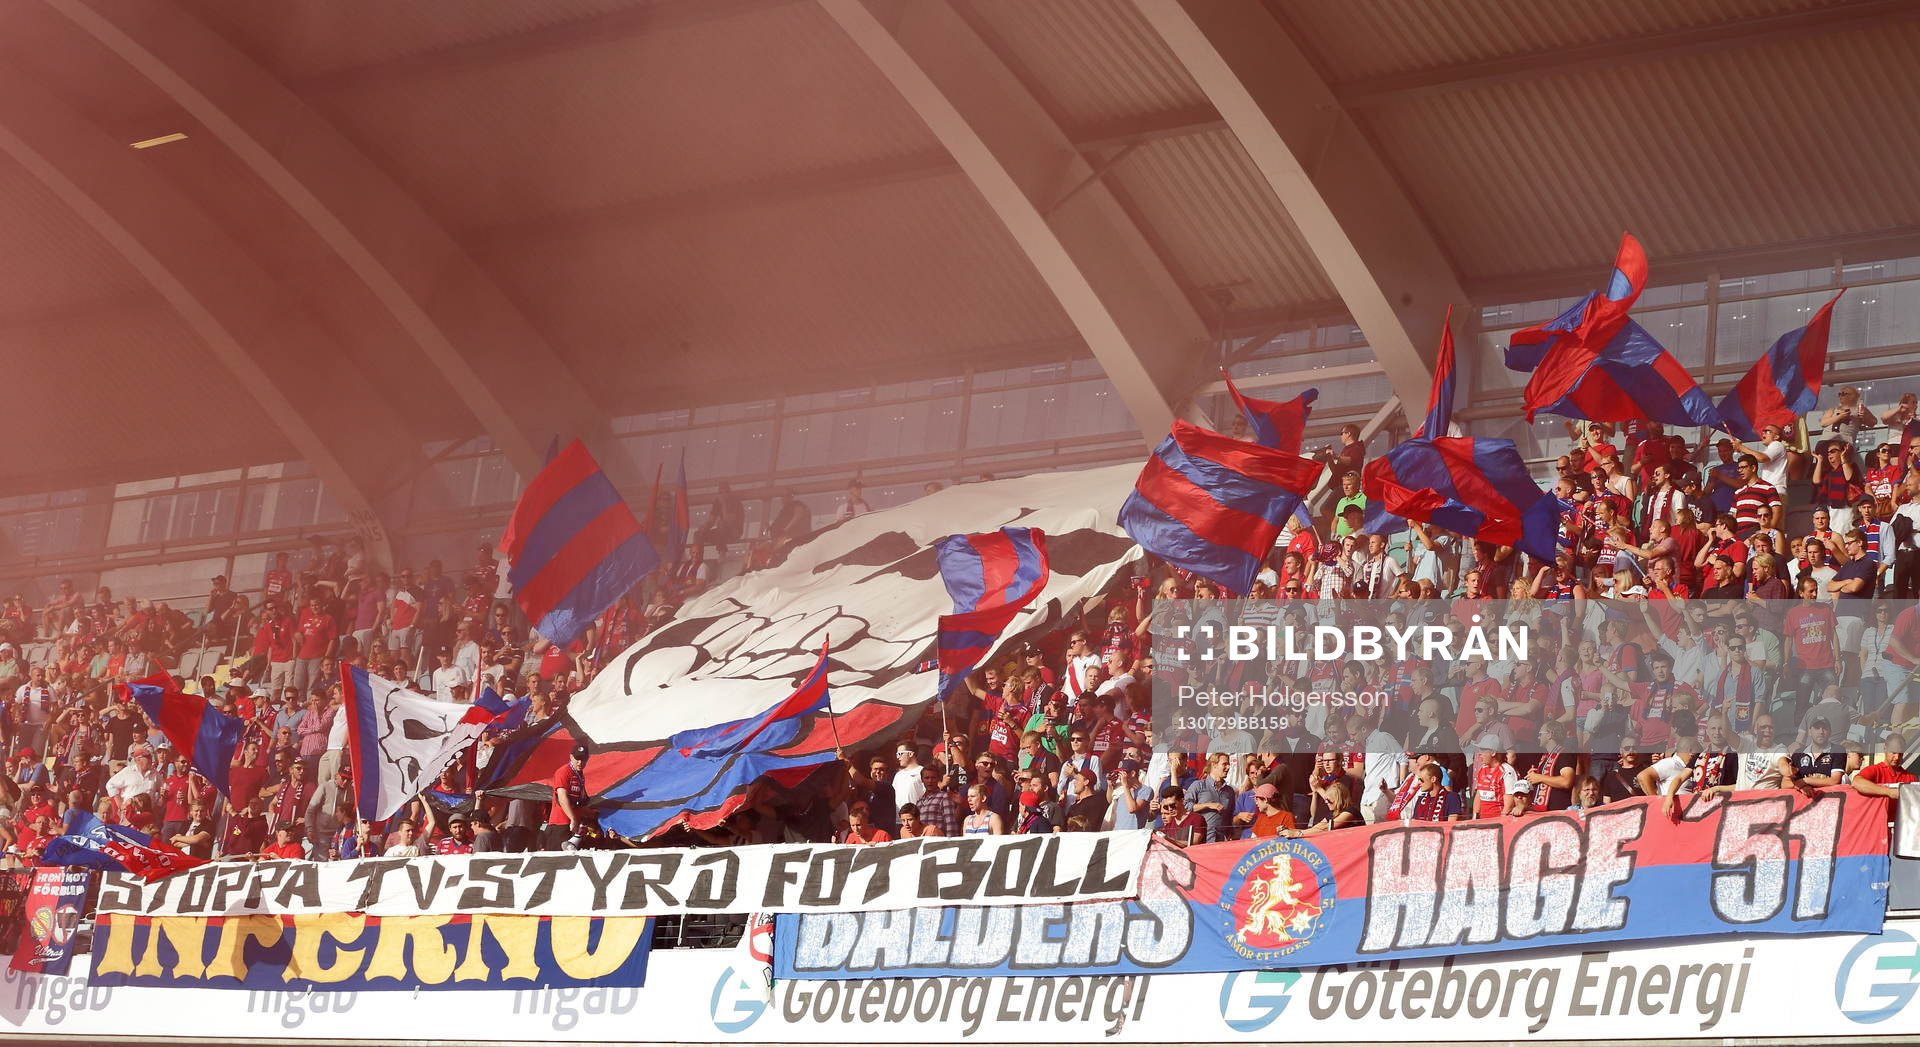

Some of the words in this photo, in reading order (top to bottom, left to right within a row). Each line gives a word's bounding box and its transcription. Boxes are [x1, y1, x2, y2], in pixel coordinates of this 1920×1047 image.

[99, 859, 322, 914] STOPPA
[347, 849, 740, 912] TV-STYRD
[762, 837, 1131, 907] FOTBOLL
[1237, 841, 1291, 877] BALDERS
[1292, 843, 1323, 870] HAGE
[1355, 803, 1648, 955] HAGE
[1225, 934, 1254, 960] AMOR
[1308, 955, 1562, 1035] Göteborg
[1568, 947, 1755, 1032] Energi
